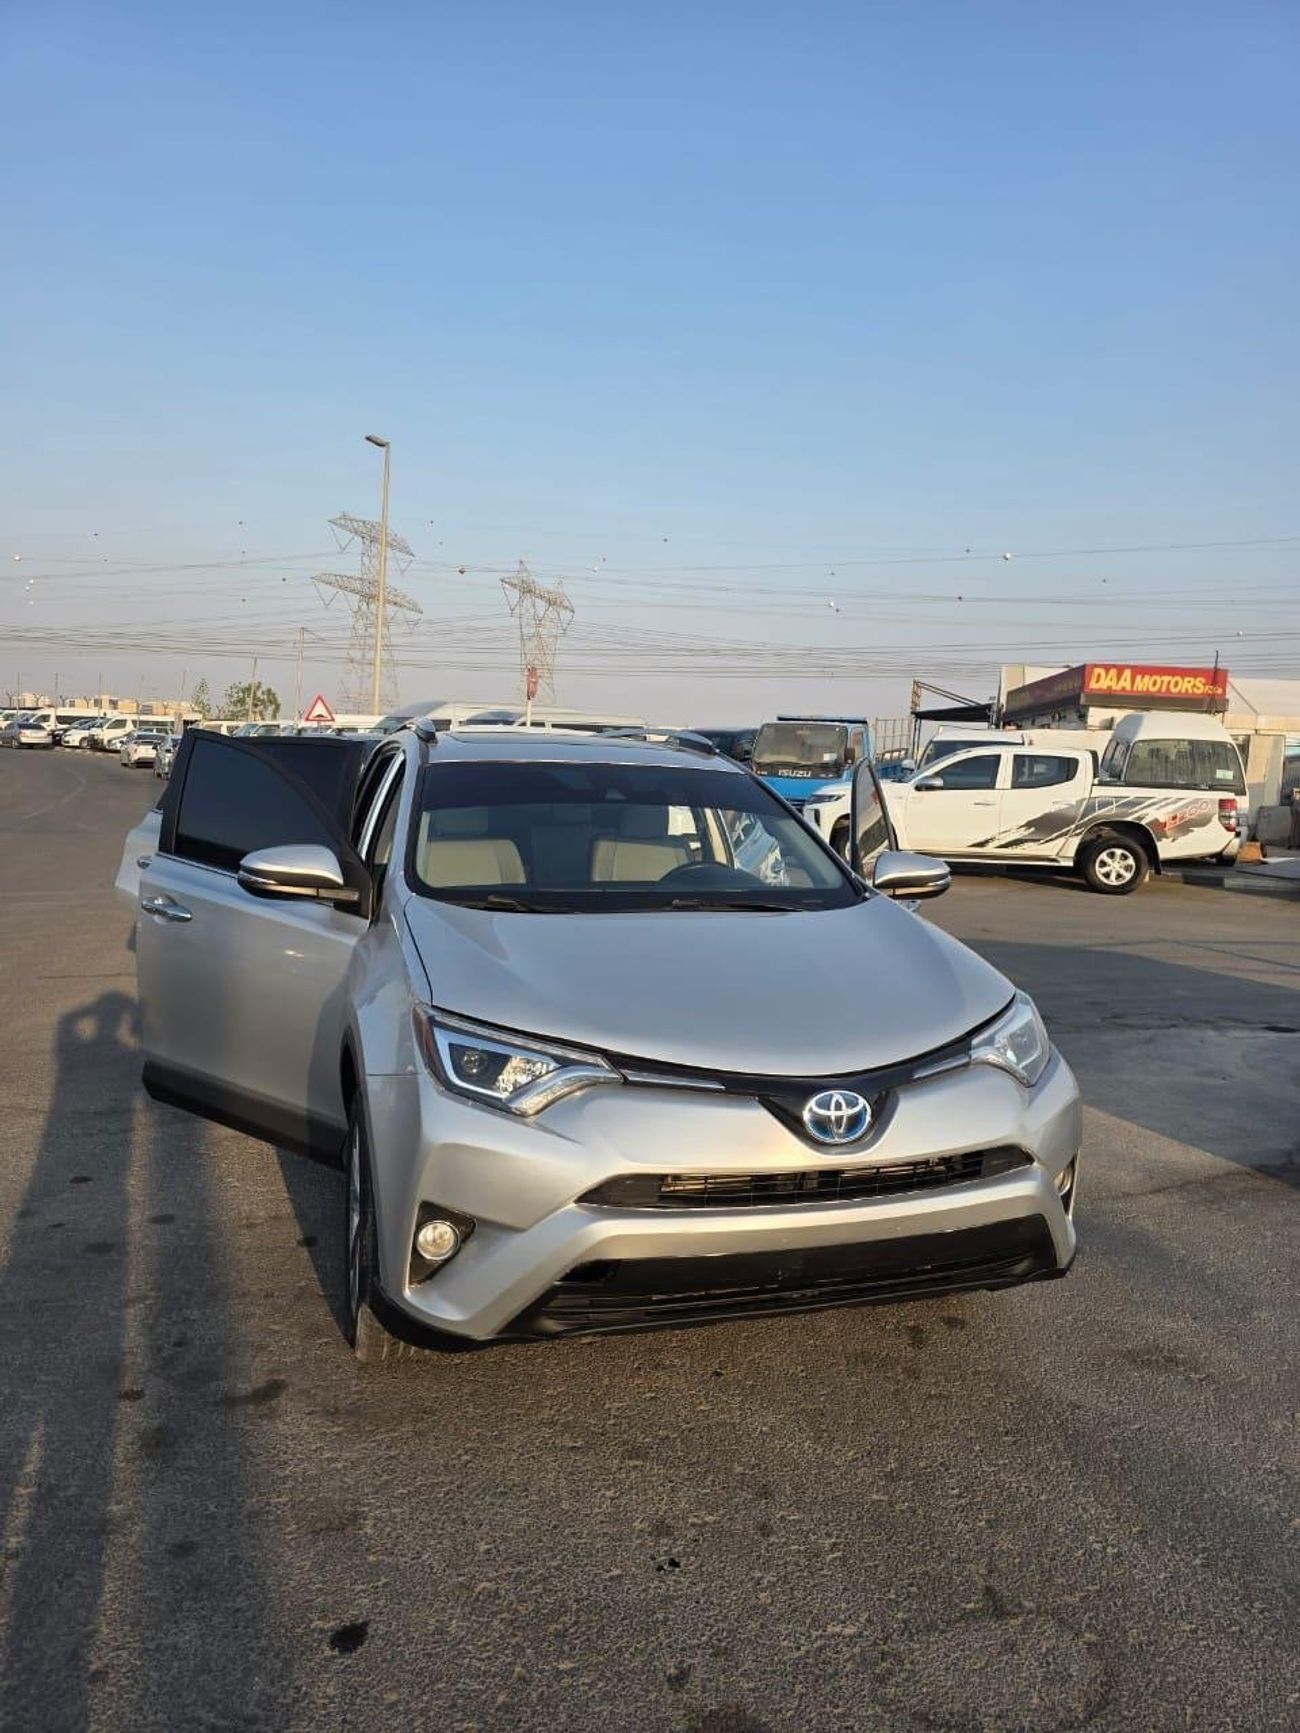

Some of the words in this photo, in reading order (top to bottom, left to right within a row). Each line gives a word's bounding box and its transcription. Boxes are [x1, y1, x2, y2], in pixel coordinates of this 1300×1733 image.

[1089, 667, 1132, 690] DAA
[1133, 674, 1205, 694] MOTORS
[778, 769, 812, 777] ISUZU
